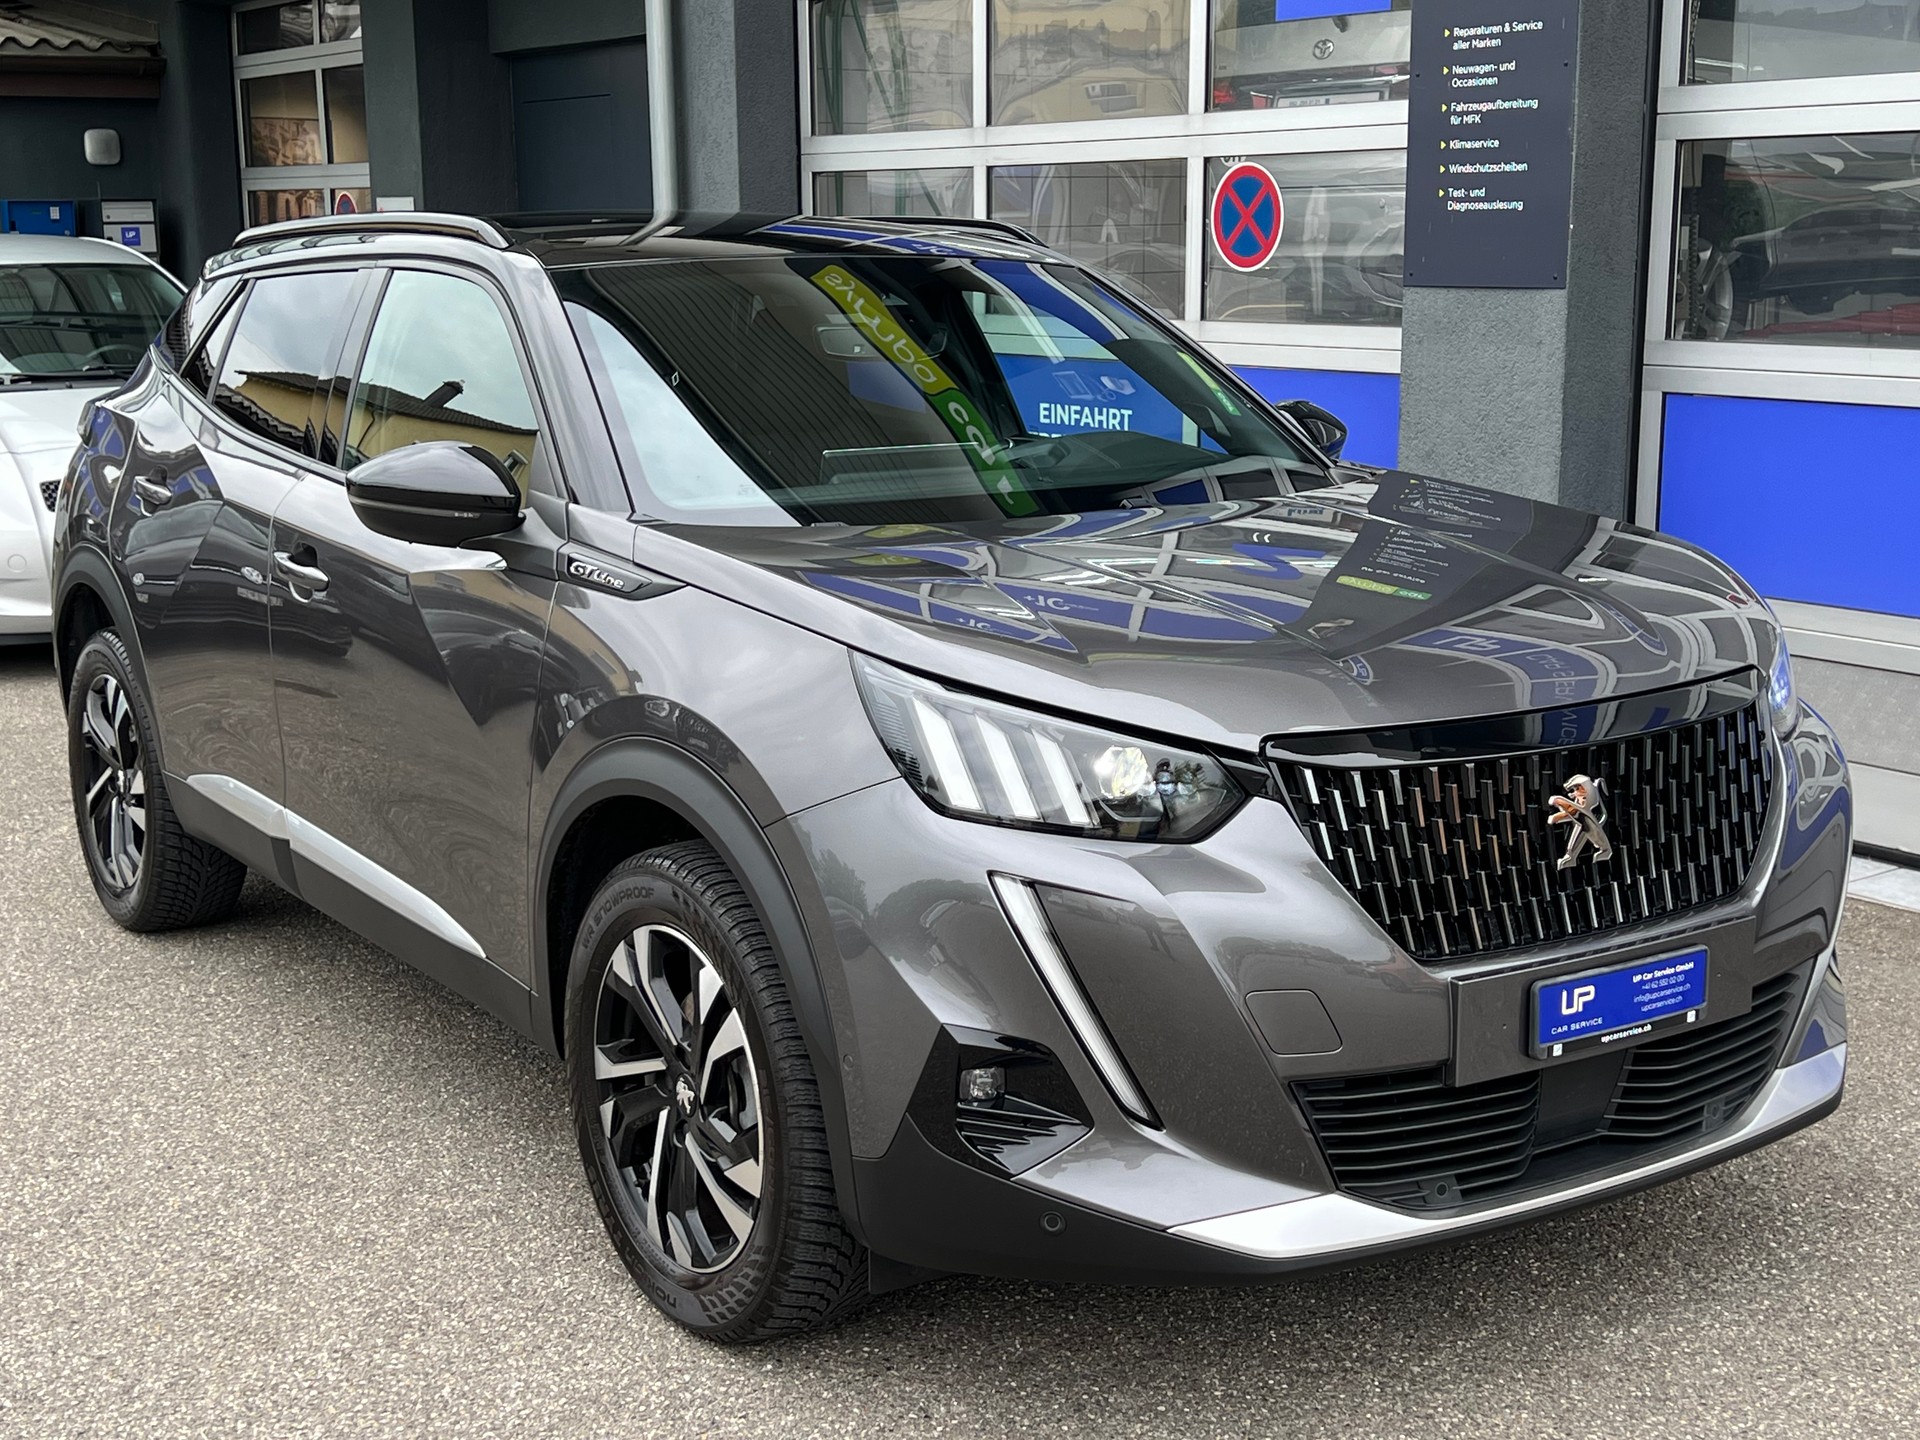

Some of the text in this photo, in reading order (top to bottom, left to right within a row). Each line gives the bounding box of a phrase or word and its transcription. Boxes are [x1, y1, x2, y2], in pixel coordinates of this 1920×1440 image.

[1453, 20, 1544, 38] Reparaturen & Service
[1452, 37, 1502, 50] aller Marken
[1452, 60, 1516, 76] Neuwagen- und
[1451, 76, 1498, 88] Occasionen
[1450, 98, 1539, 112] Fahrzeugaufbereitung
[1450, 114, 1482, 125] für MFK
[1449, 138, 1500, 150] Klimaservice
[1448, 161, 1528, 174] Windschutzscheiben
[1447, 187, 1486, 198] Test- und
[1447, 200, 1524, 211] Diagnoseauslesung
[1039, 402, 1133, 431] EINFAHRT
[1632, 961, 1695, 983] UP Car Service GmbH
[1561, 984, 1596, 1016] UP
[1551, 1016, 1603, 1035] CAR SERVICE
[1601, 1023, 1652, 1043] upcarservice.ch
